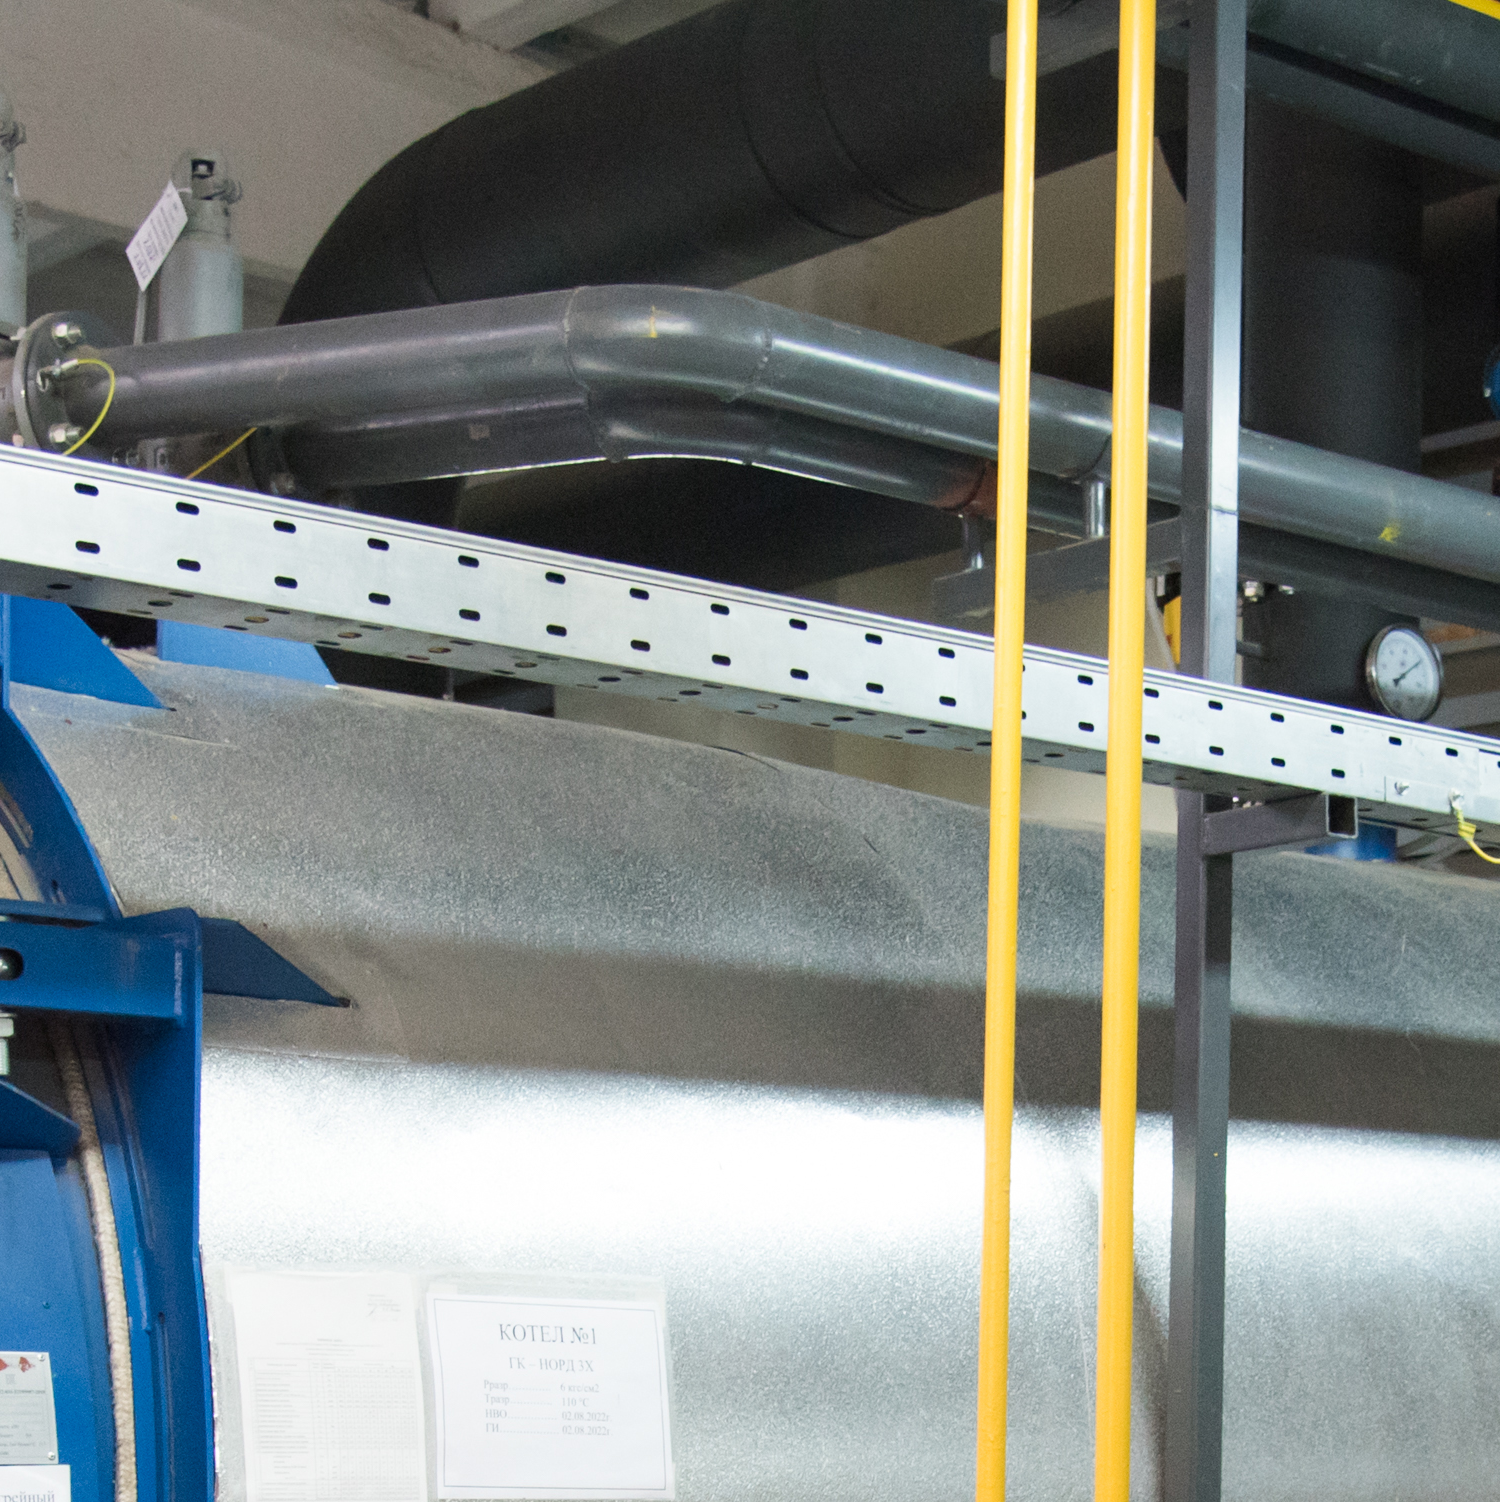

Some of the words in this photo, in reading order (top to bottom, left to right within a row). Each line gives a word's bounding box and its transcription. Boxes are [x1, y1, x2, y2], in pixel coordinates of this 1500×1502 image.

[498, 1323, 565, 1343] КОТЕЛ
[570, 1326, 597, 1345] №1
[508, 1356, 526, 1369] ГК
[539, 1357, 576, 1373] НОРД
[560, 1383, 566, 1392] 6
[561, 1397, 577, 1407] 110
